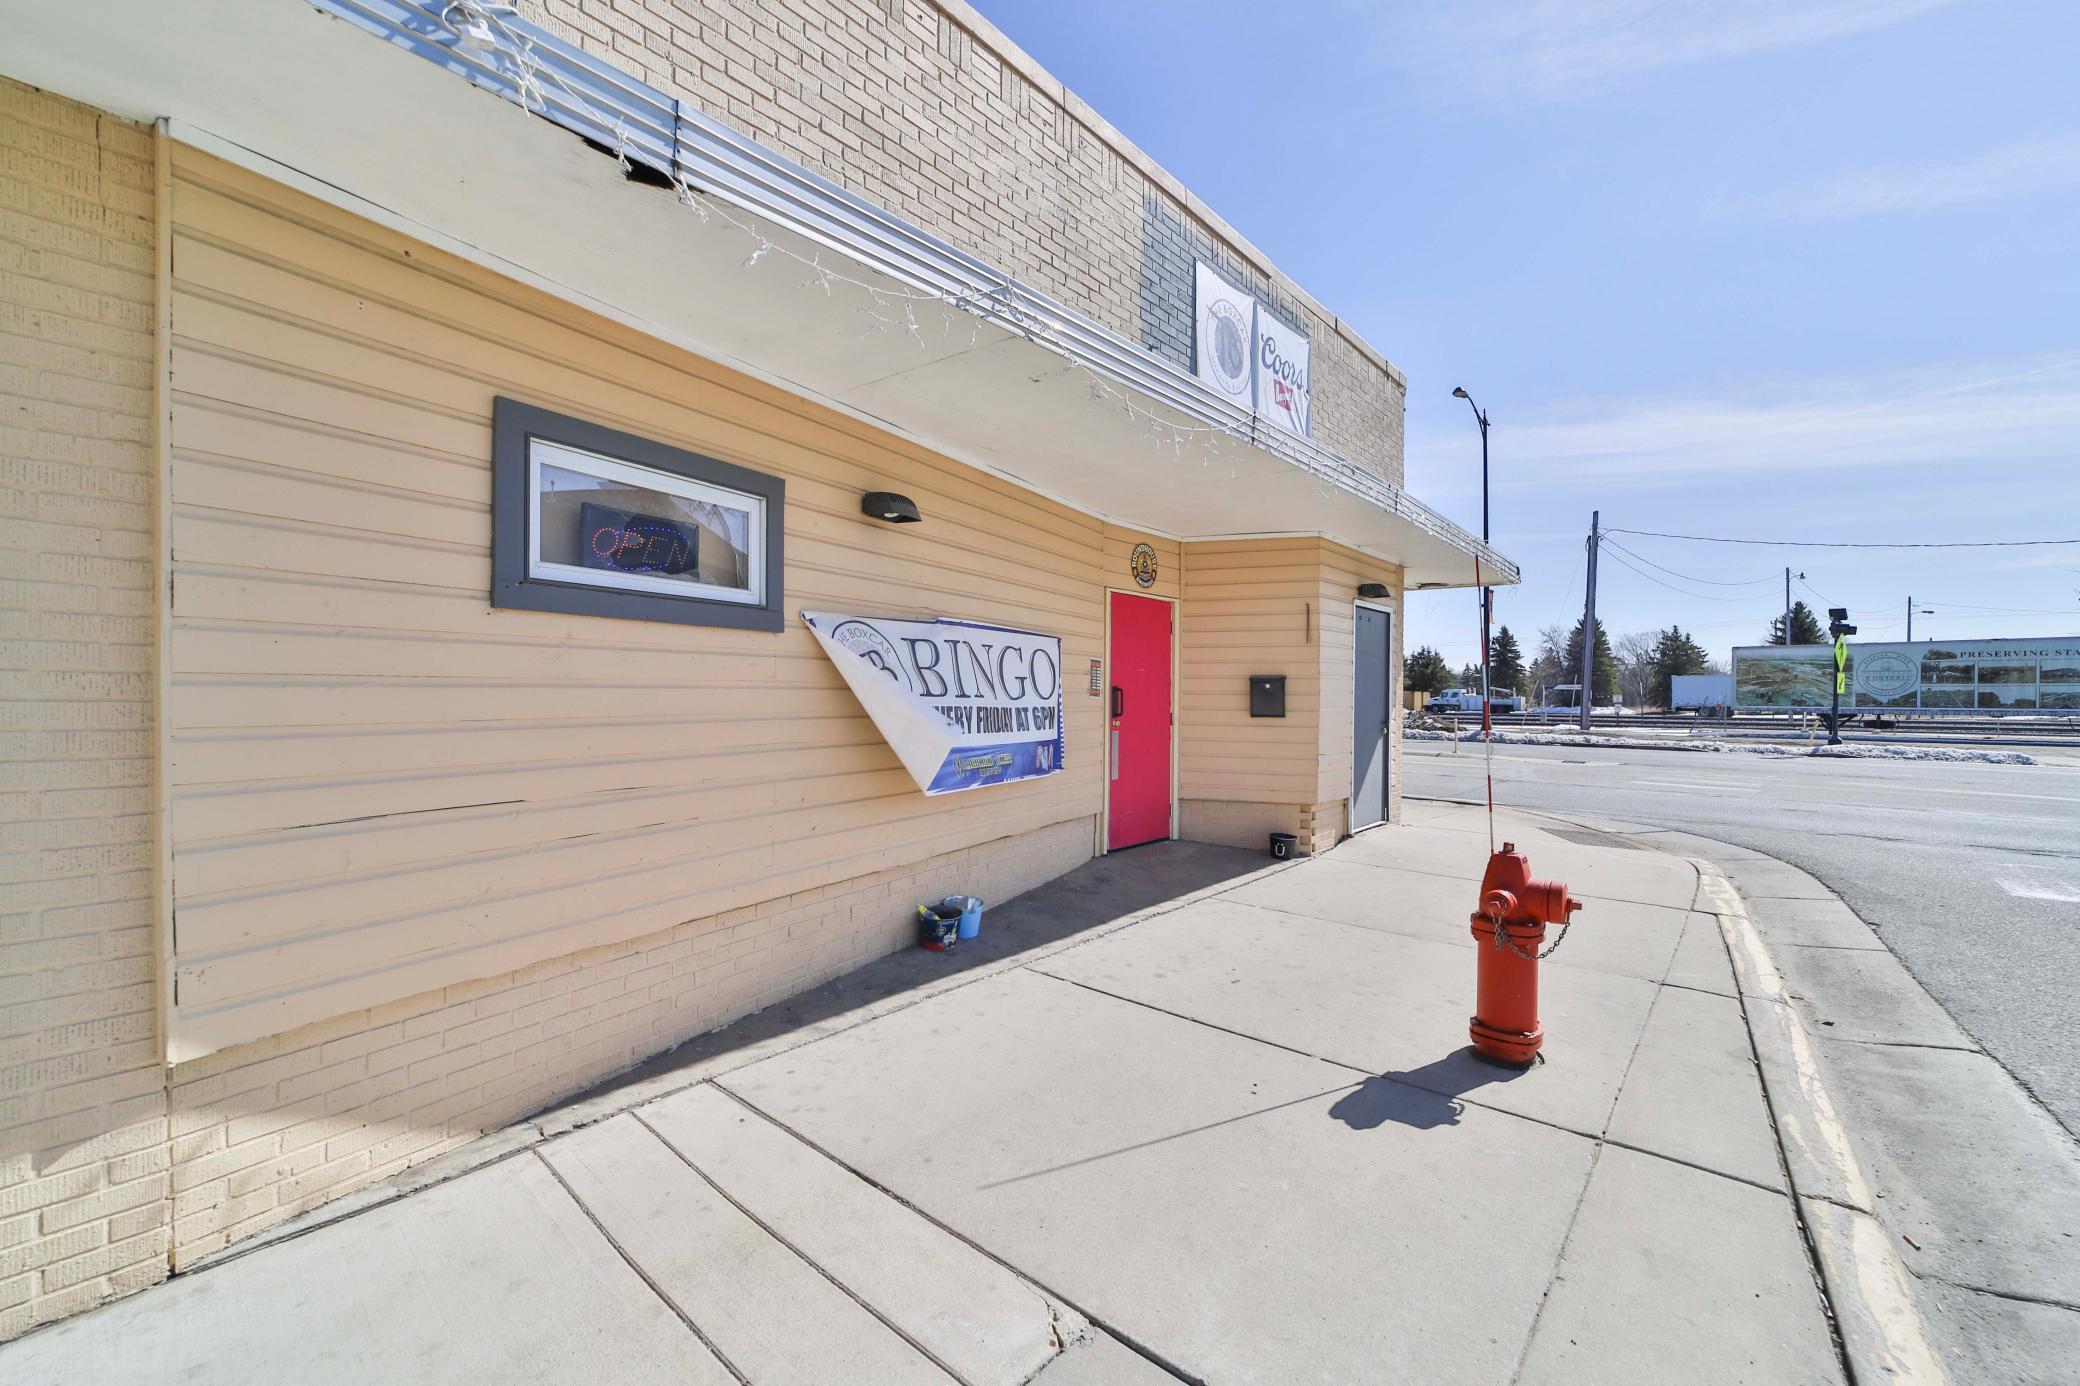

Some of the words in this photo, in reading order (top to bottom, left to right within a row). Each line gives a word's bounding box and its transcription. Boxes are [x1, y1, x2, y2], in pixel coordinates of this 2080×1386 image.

[1261, 334, 1304, 391] Coors
[592, 527, 692, 568] OPEN
[1132, 544, 1157, 571] ROUNDHOUSE
[847, 627, 891, 657] BOXCAR
[1960, 650, 2049, 658] PRESERVING
[901, 638, 1056, 700] BINGO
[1015, 707, 1030, 732] AT
